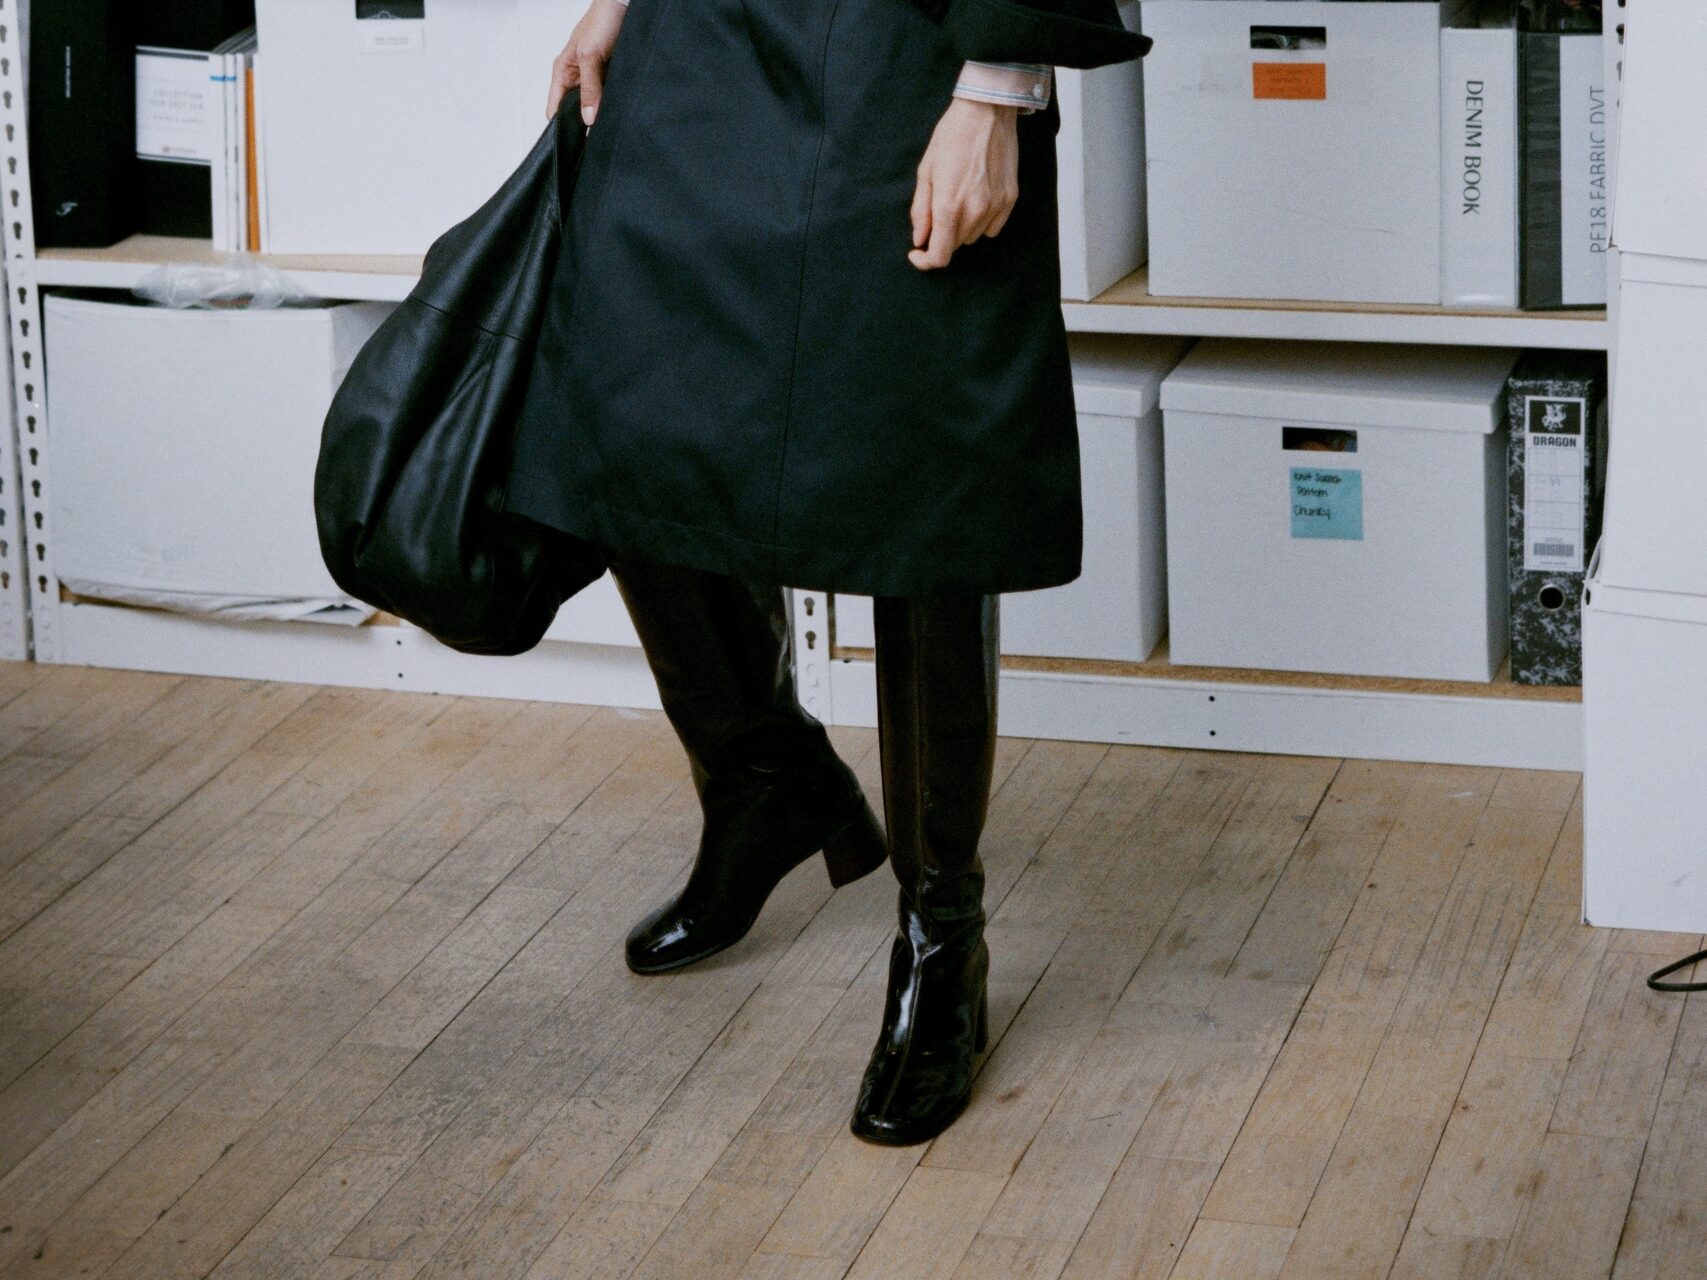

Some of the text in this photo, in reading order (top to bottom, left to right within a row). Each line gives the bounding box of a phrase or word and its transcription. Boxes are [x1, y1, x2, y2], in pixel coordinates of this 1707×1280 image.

[1590, 86, 1605, 125] DVT
[1462, 80, 1484, 215] DENIM BOOK
[1533, 435, 1577, 448] DRAGON
